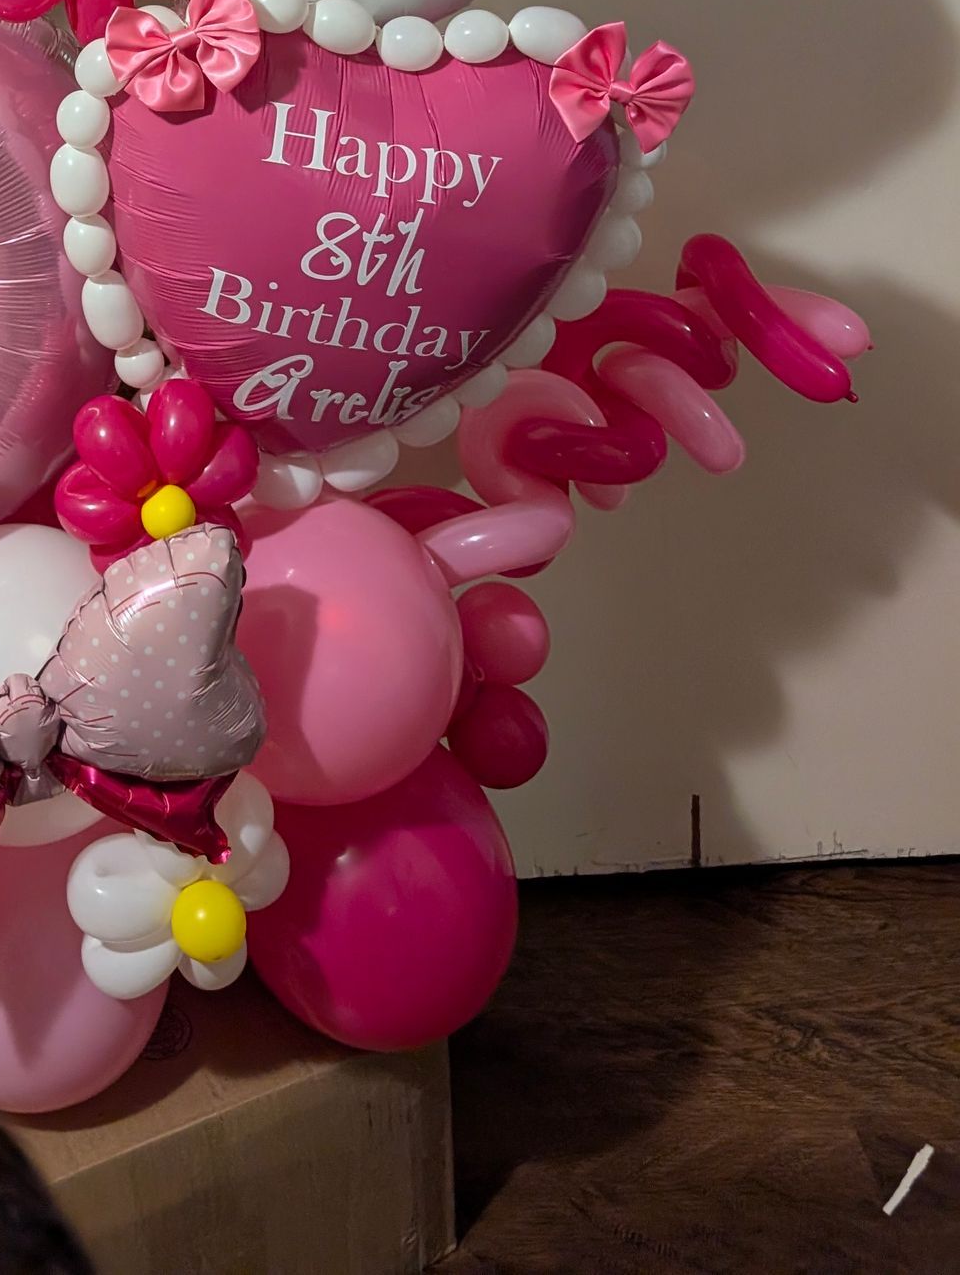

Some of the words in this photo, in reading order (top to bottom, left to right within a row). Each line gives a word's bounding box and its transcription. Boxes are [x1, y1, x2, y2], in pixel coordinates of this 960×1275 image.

[261, 101, 503, 208] Happy
[300, 208, 425, 297] 8th
[196, 266, 490, 371] Birthday
